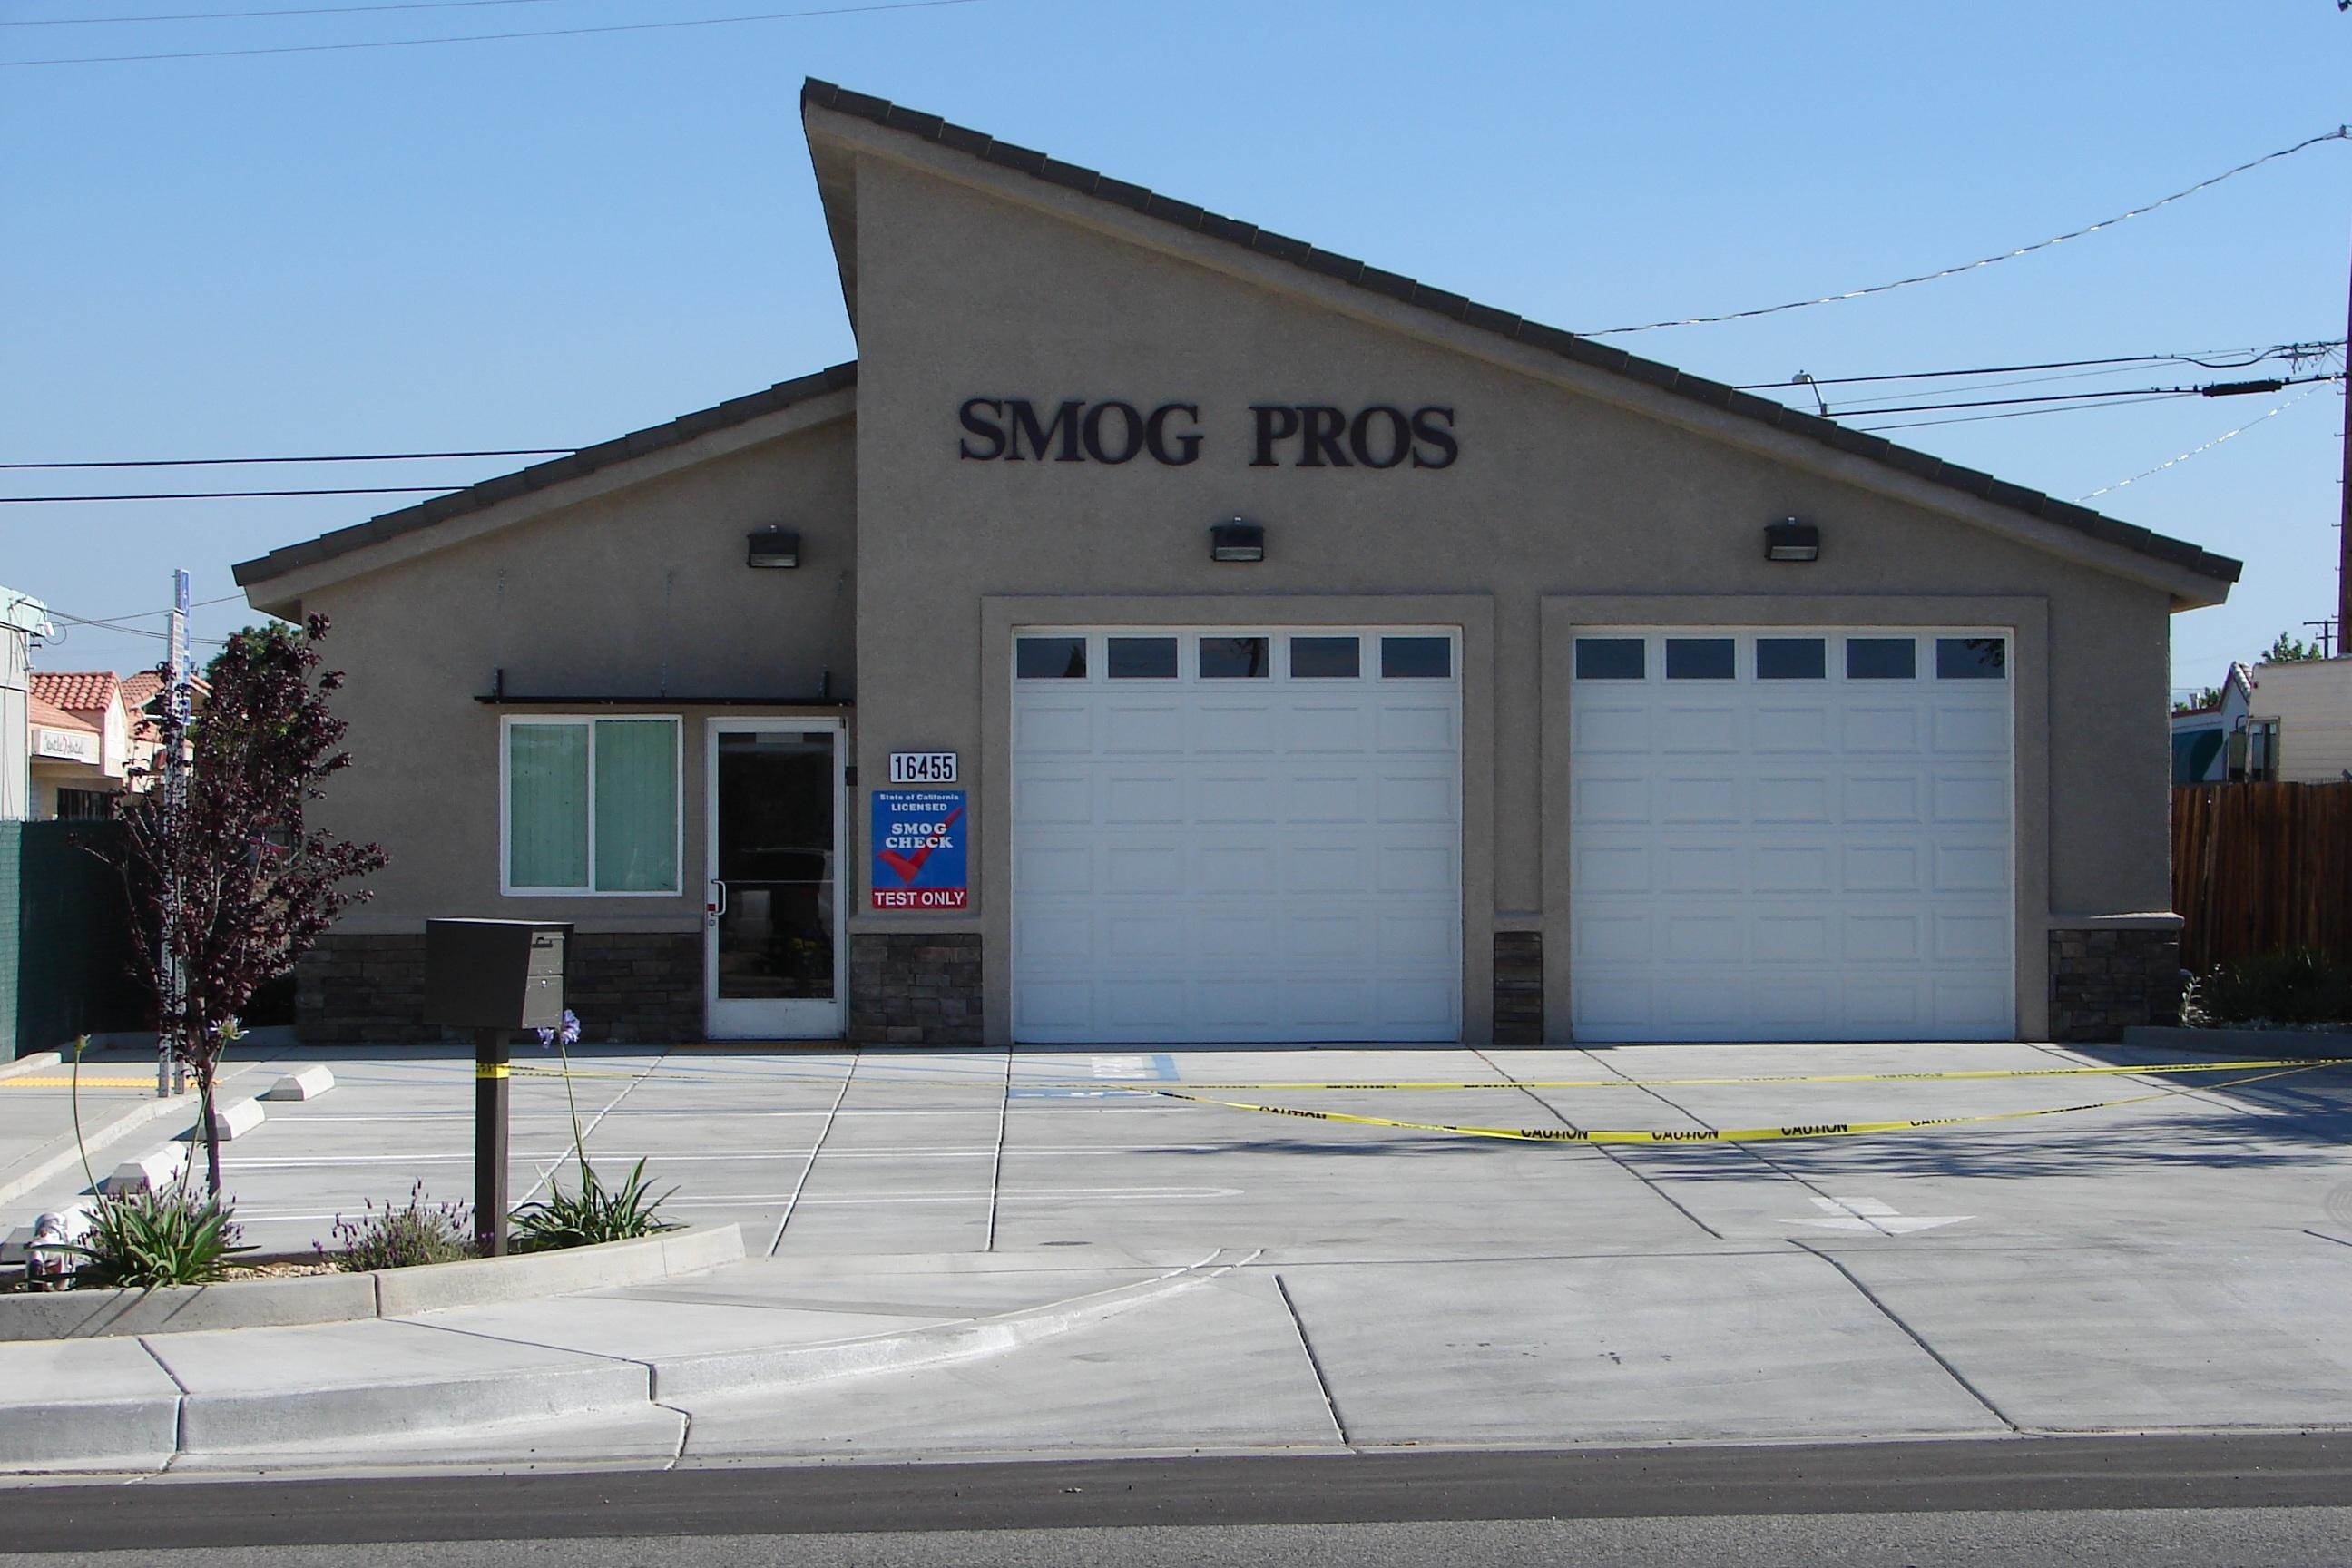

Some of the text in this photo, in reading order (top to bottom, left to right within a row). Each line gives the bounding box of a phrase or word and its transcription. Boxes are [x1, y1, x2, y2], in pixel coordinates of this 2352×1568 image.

[958, 397, 1459, 470] SMOG PROS
[895, 755, 953, 780] 16455
[879, 793, 959, 801] State of California
[891, 803, 947, 812] LICENSED
[891, 822, 947, 835] SMOG
[885, 837, 954, 848] CHECK
[875, 891, 965, 906] TEST ONLY
